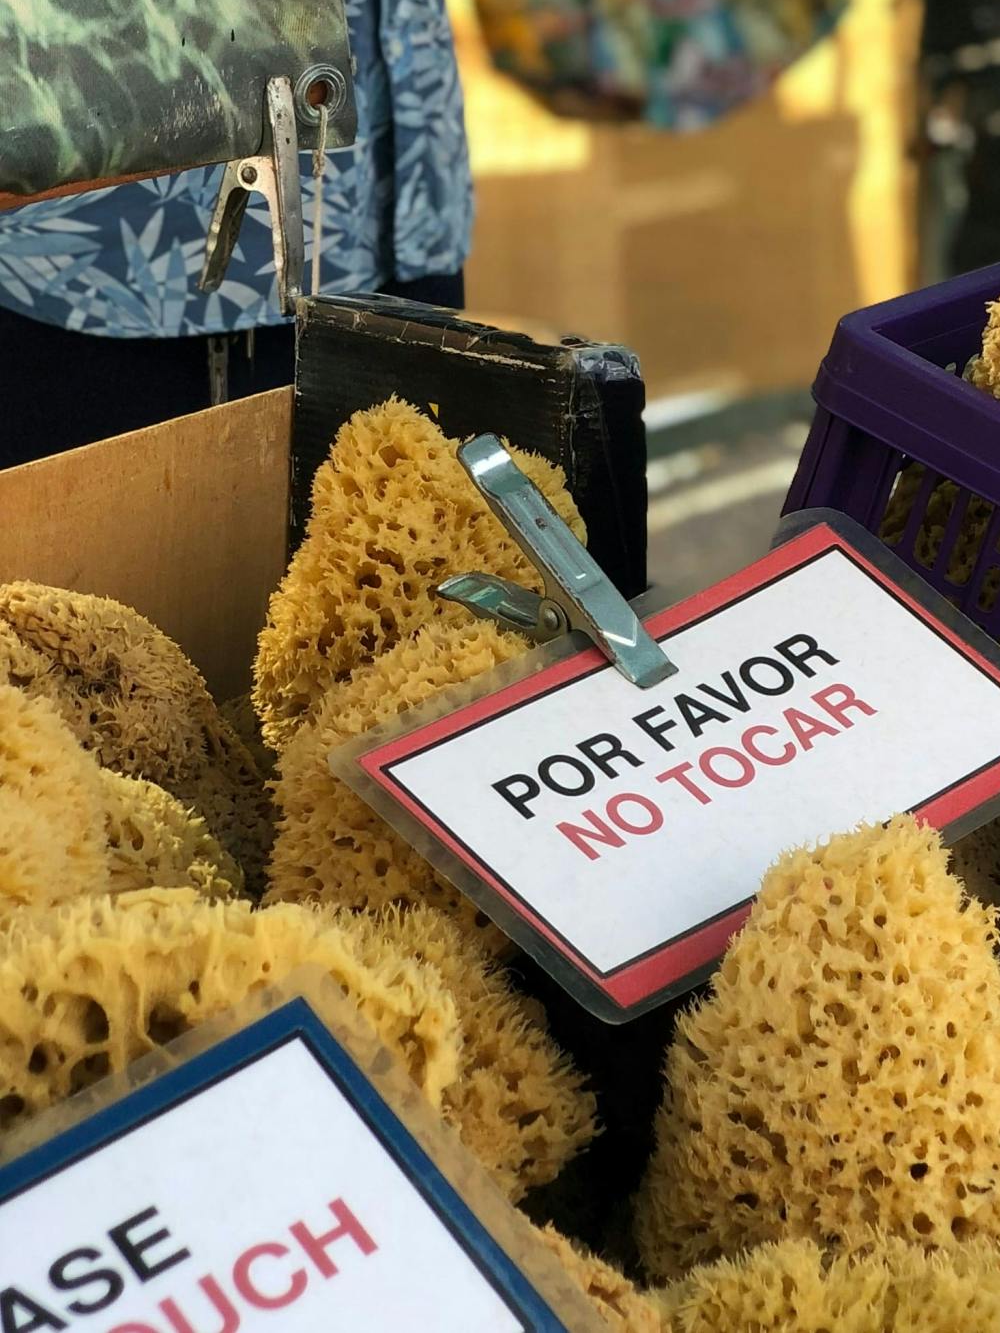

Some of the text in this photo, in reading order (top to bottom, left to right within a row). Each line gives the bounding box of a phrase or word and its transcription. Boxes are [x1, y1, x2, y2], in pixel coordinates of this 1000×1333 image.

[491, 632, 842, 821] POR FAVOR
[554, 682, 879, 862] NO TOCAR
[0, 1205, 192, 1333] ASE
[105, 1197, 379, 1333] UCH
